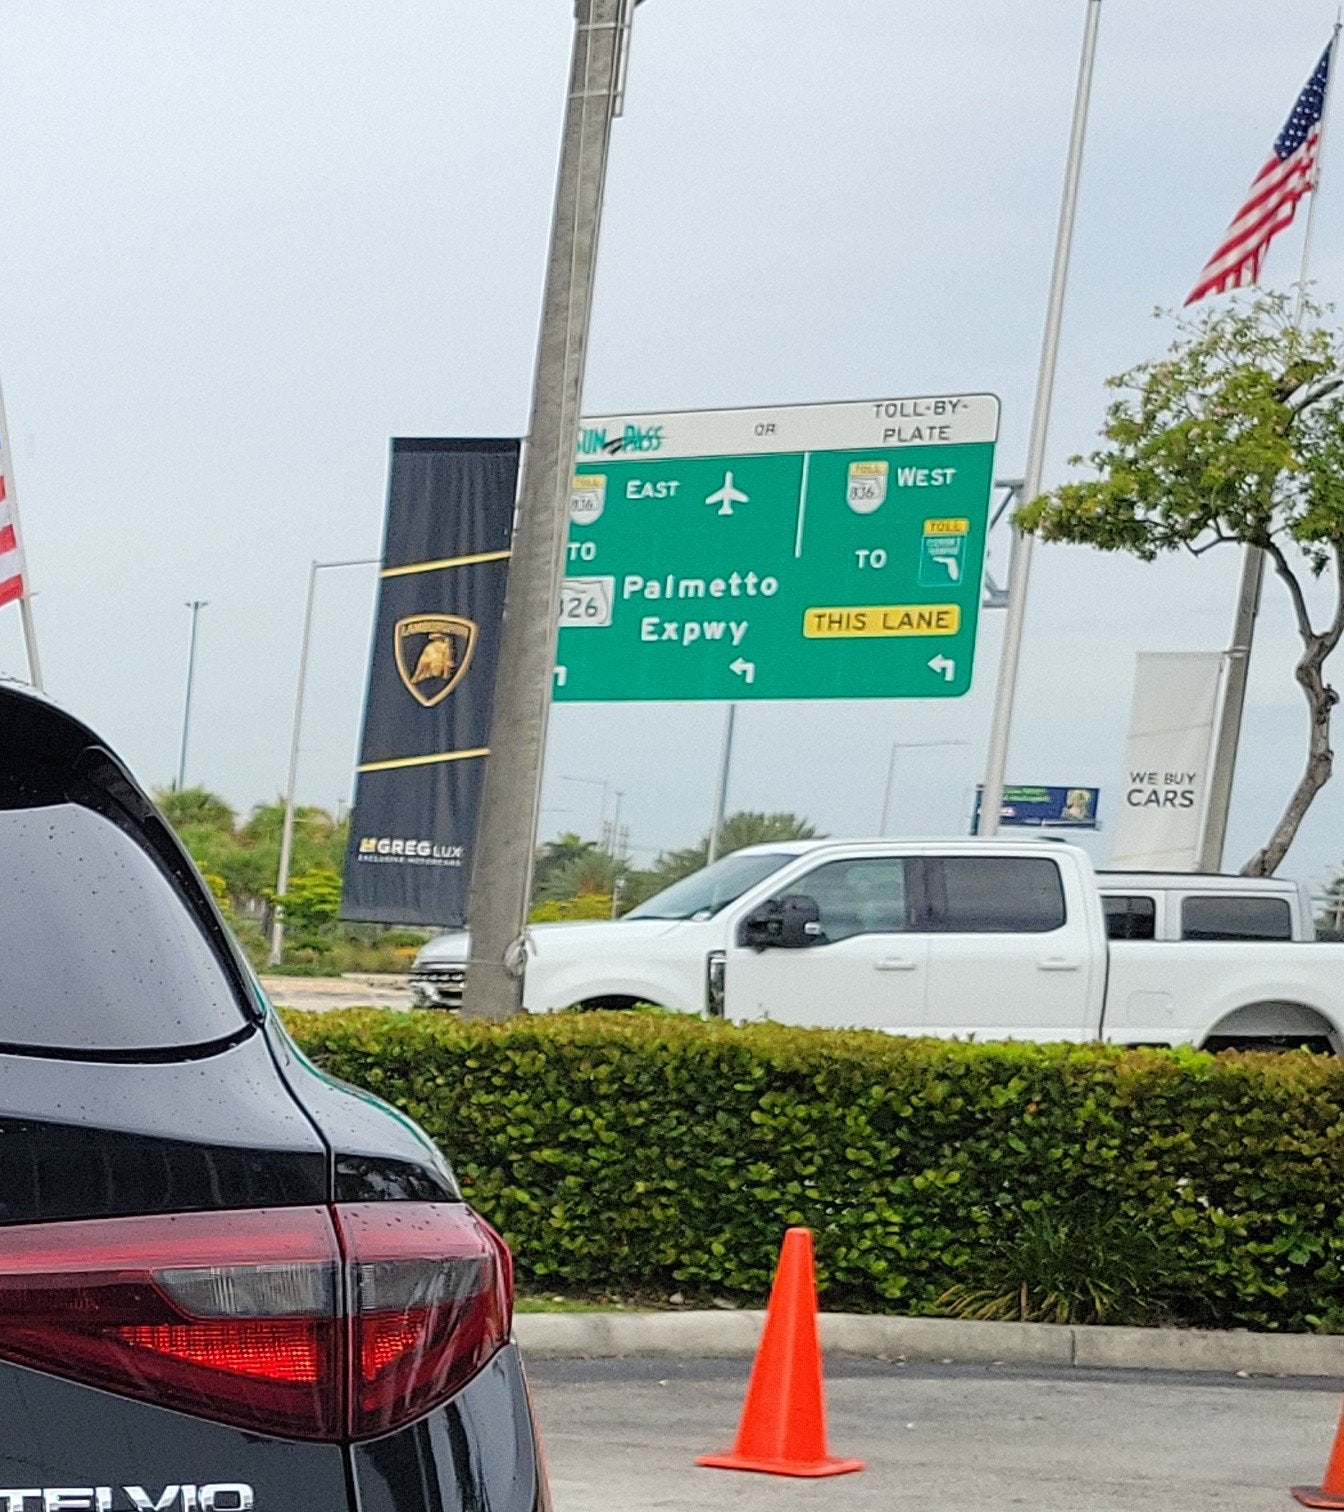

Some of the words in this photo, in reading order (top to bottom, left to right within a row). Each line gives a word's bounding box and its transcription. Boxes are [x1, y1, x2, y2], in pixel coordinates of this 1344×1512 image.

[873, 399, 969, 419] TOLL-BY-
[753, 422, 776, 436] OR
[883, 425, 952, 443] PLATE
[897, 467, 957, 487] WEST
[626, 480, 681, 499] EAST
[567, 541, 597, 561] TO
[855, 548, 888, 569] TO
[623, 571, 779, 600] Palmetto
[814, 613, 867, 632] THIS
[882, 610, 951, 630] LANE
[640, 616, 749, 647] Expwy
[1129, 771, 1159, 786] WE
[1164, 771, 1197, 786] BUY
[1126, 788, 1195, 809] CARS
